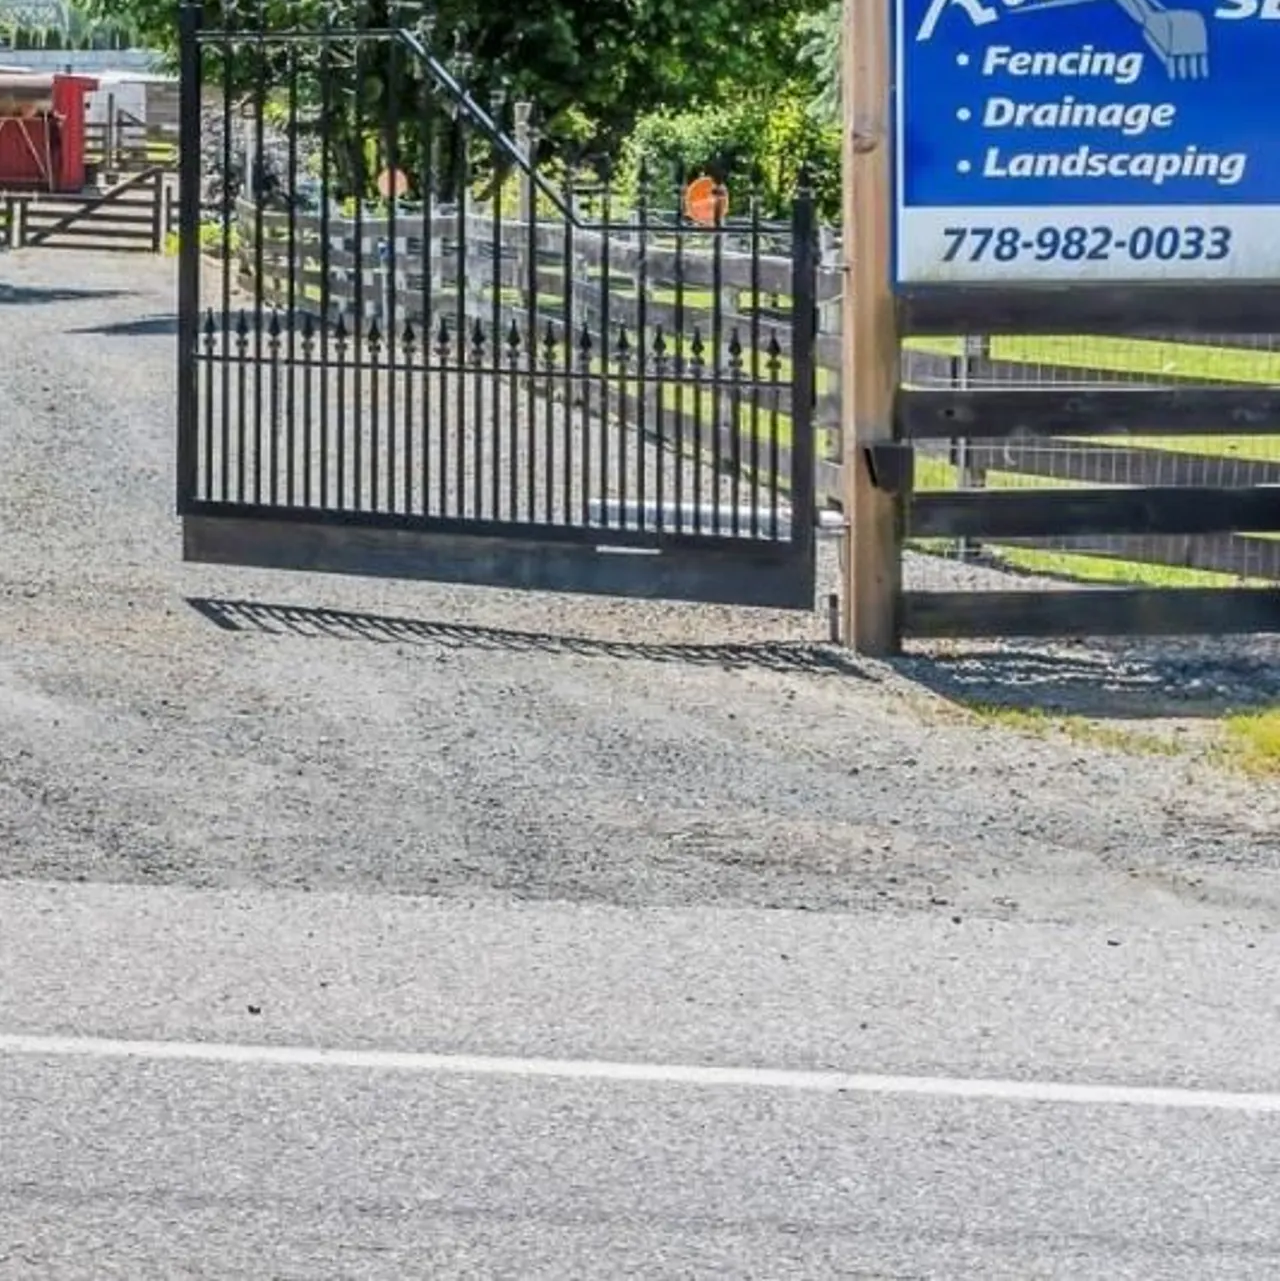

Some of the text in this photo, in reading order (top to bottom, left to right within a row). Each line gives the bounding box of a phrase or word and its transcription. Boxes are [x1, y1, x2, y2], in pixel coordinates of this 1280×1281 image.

[982, 45, 1144, 84] Fencing
[983, 96, 1176, 135] Drainage
[983, 146, 1246, 185] Landscaping
[942, 226, 1232, 262] 778-982-0033
